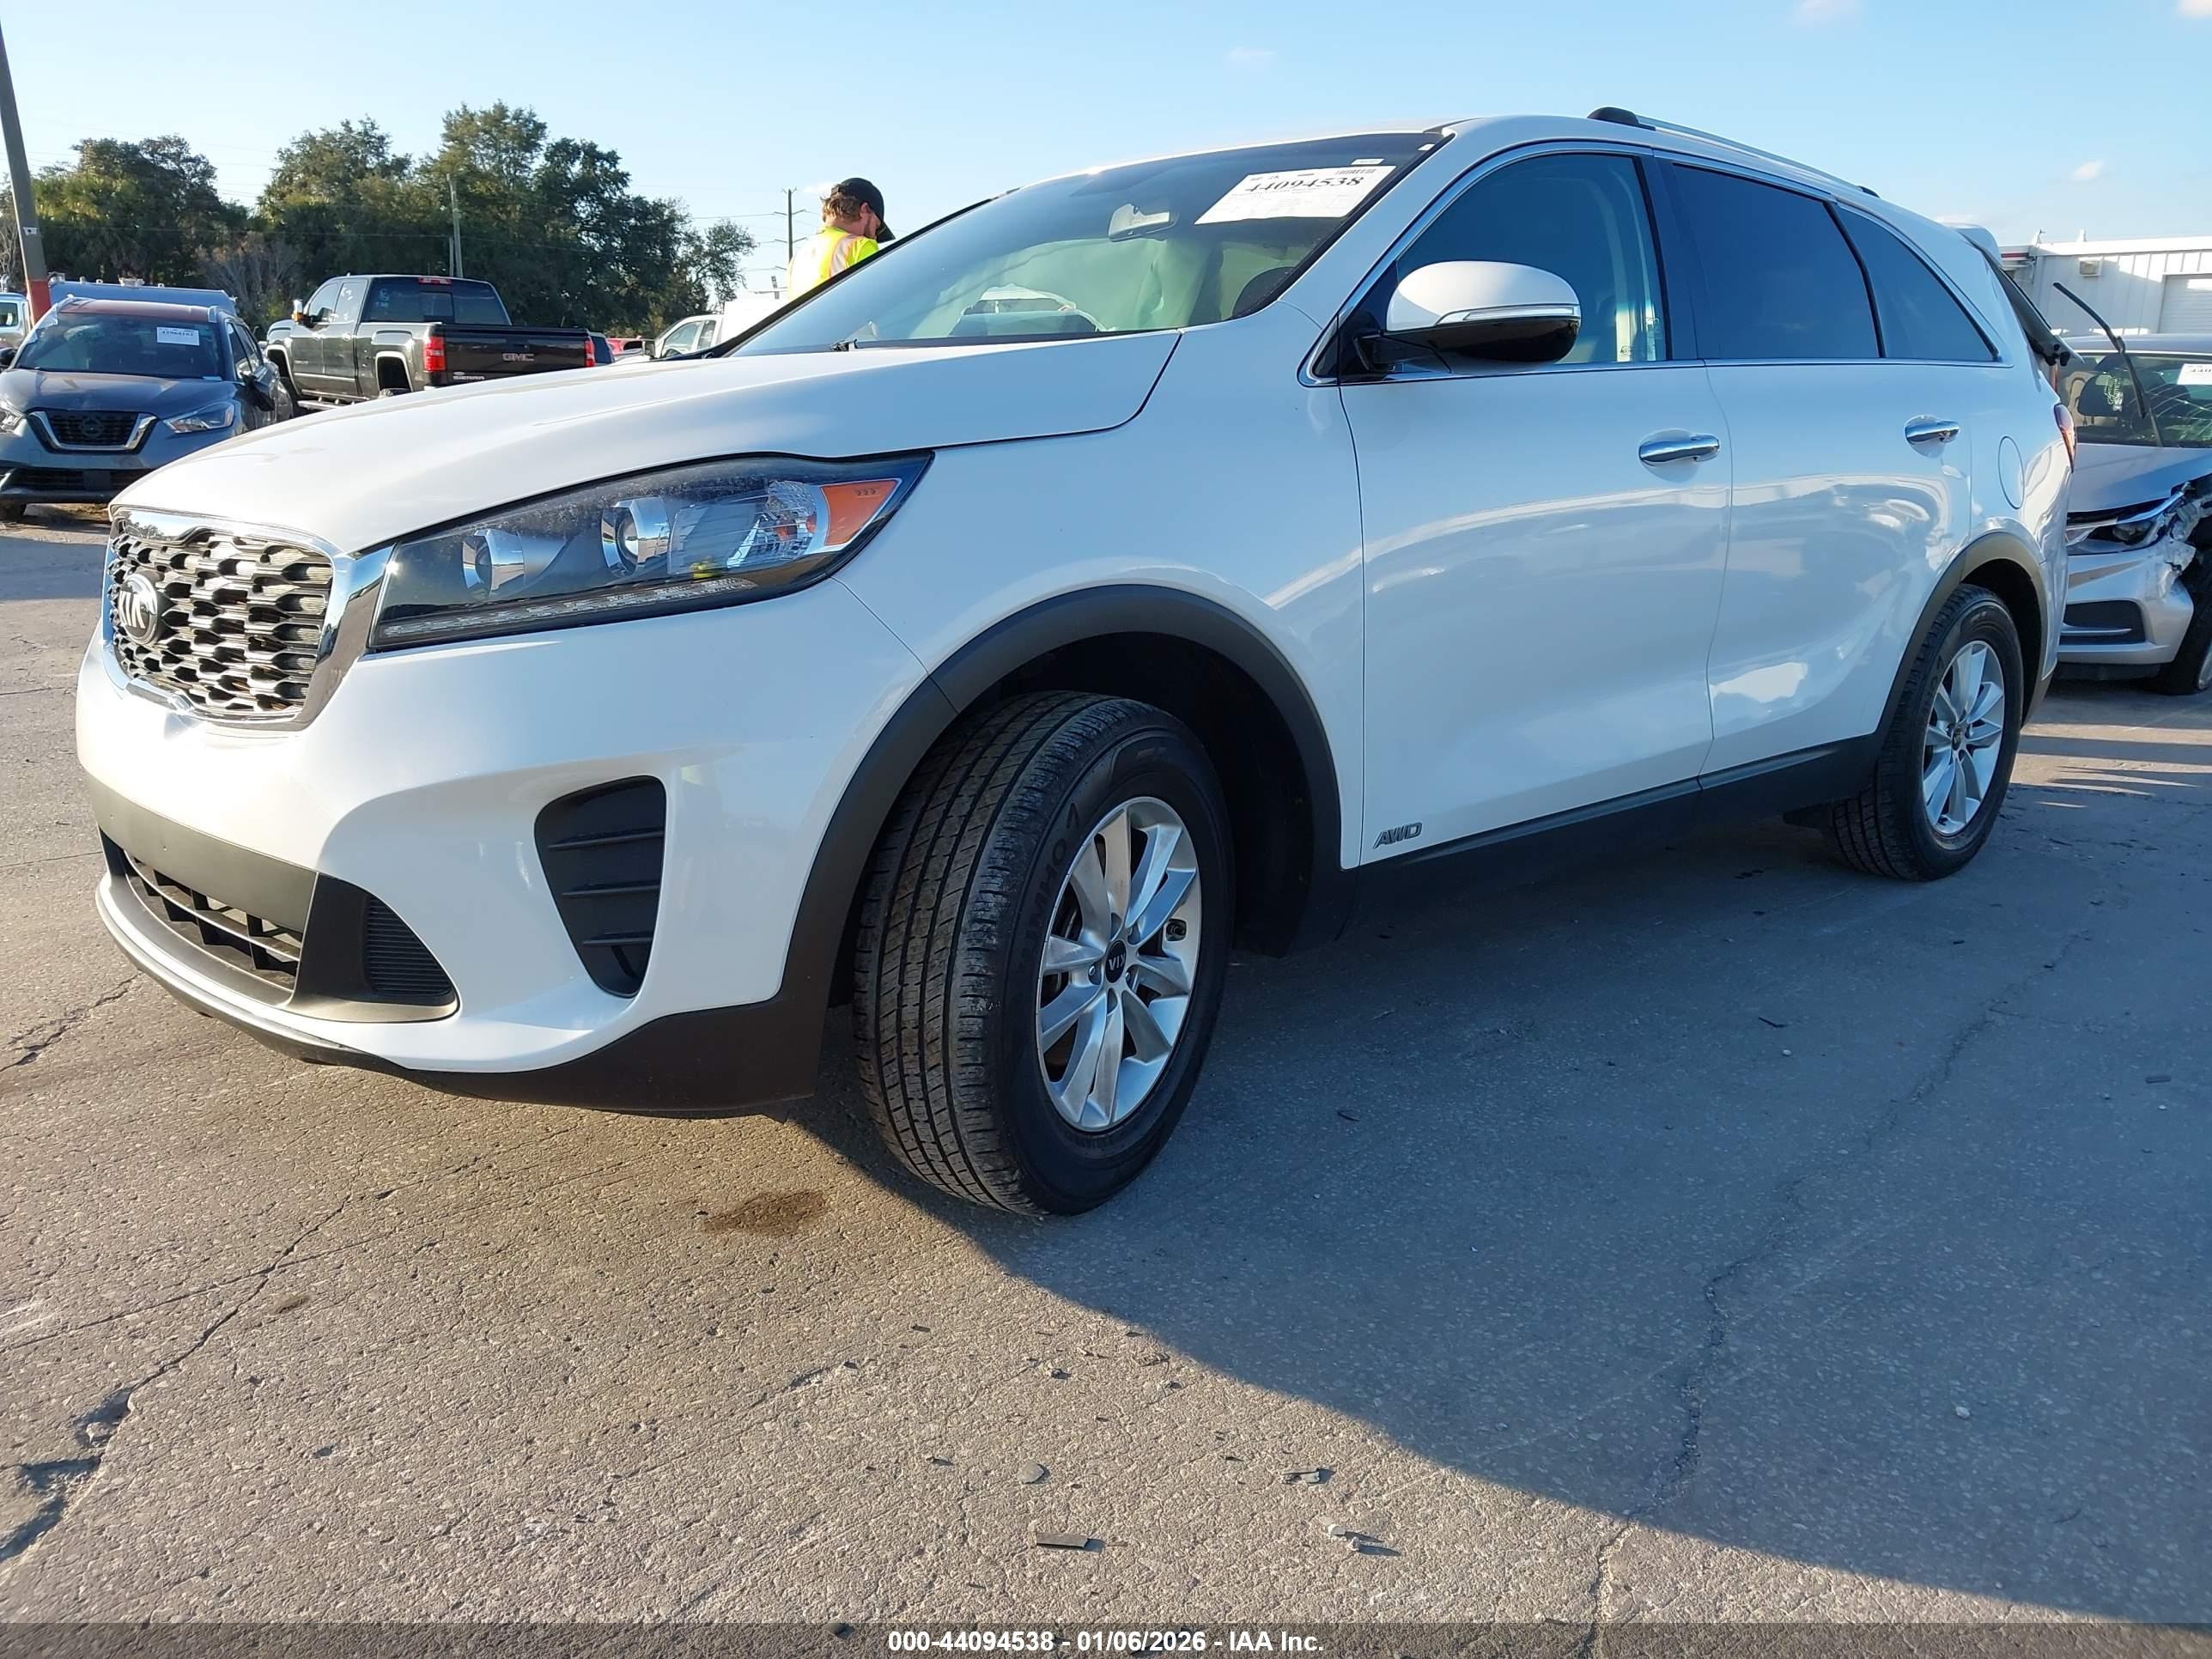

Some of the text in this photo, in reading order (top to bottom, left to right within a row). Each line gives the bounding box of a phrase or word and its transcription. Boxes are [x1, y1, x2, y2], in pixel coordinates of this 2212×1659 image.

[1245, 177, 1364, 191] 44094538
[502, 353, 534, 362] GMC
[119, 590, 146, 629] KIA
[1373, 822, 1422, 849] AWD
[1109, 953, 1126, 970] KIA
